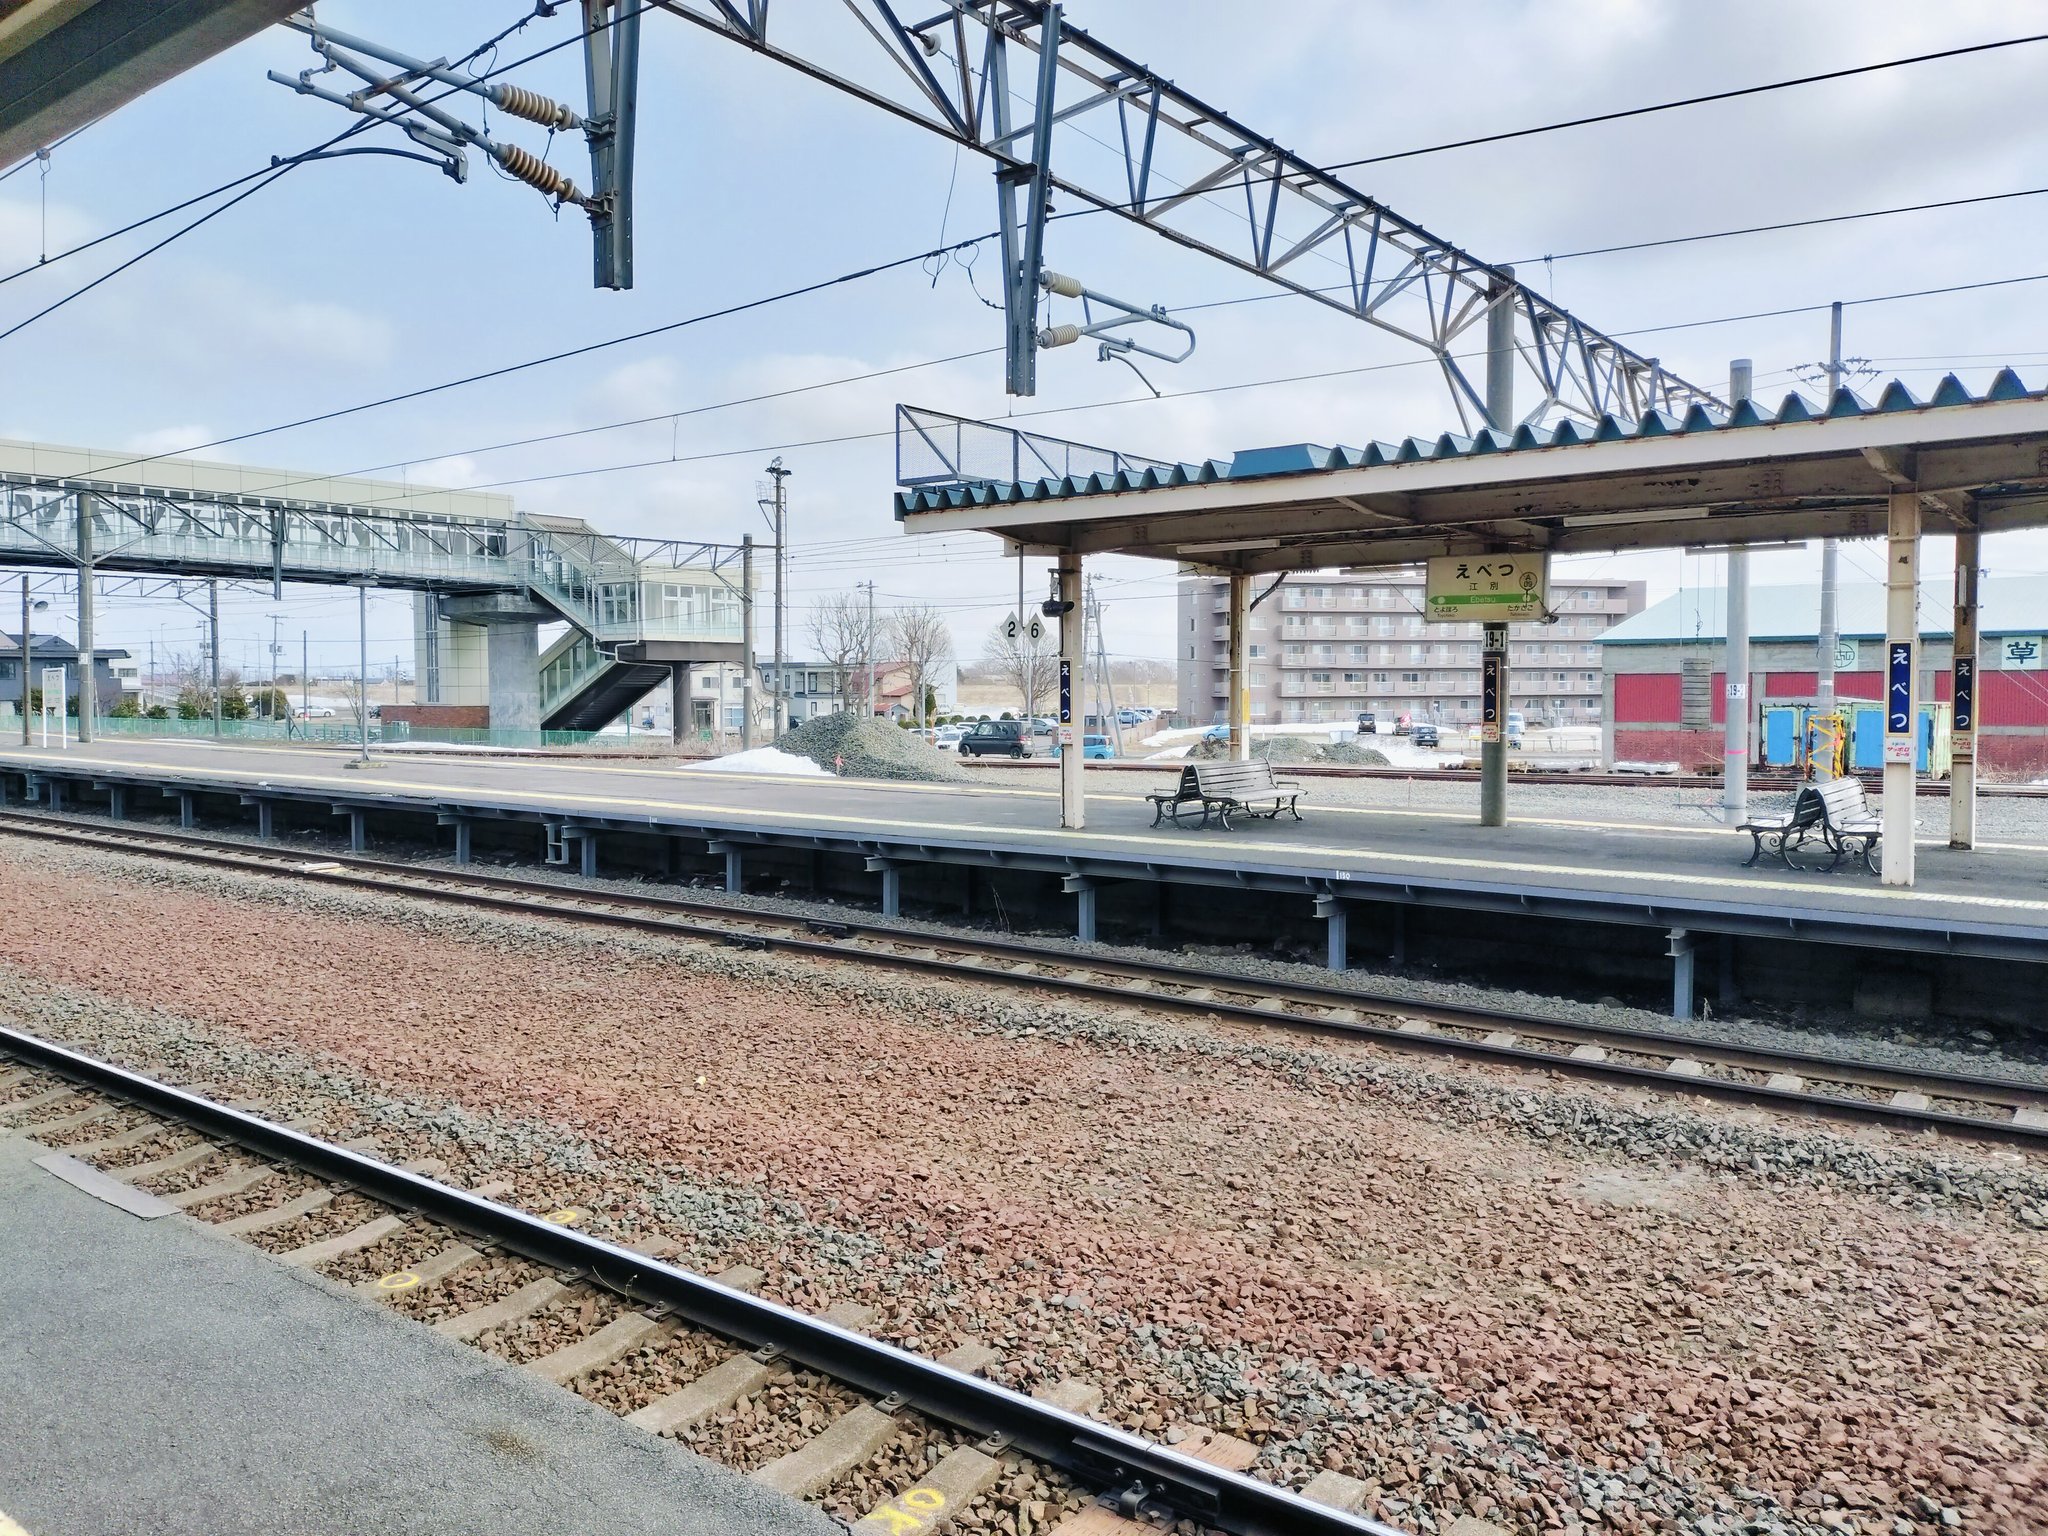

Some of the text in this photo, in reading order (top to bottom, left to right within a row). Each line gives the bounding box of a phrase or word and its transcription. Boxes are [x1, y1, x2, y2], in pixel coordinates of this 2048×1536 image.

[1456, 563, 1514, 579] えべつ
[1523, 580, 1533, 588] 09
[1470, 595, 1496, 604] Ebetsu
[1007, 621, 1016, 638] 2
[1030, 622, 1039, 639] 6
[1485, 631, 1504, 648] 19-1
[2006, 641, 2039, 665] 草
[1061, 664, 1070, 720] えべつ
[1485, 664, 1496, 720] えべつ
[1891, 648, 1909, 728] えべつ
[1956, 663, 1971, 727] えべつ
